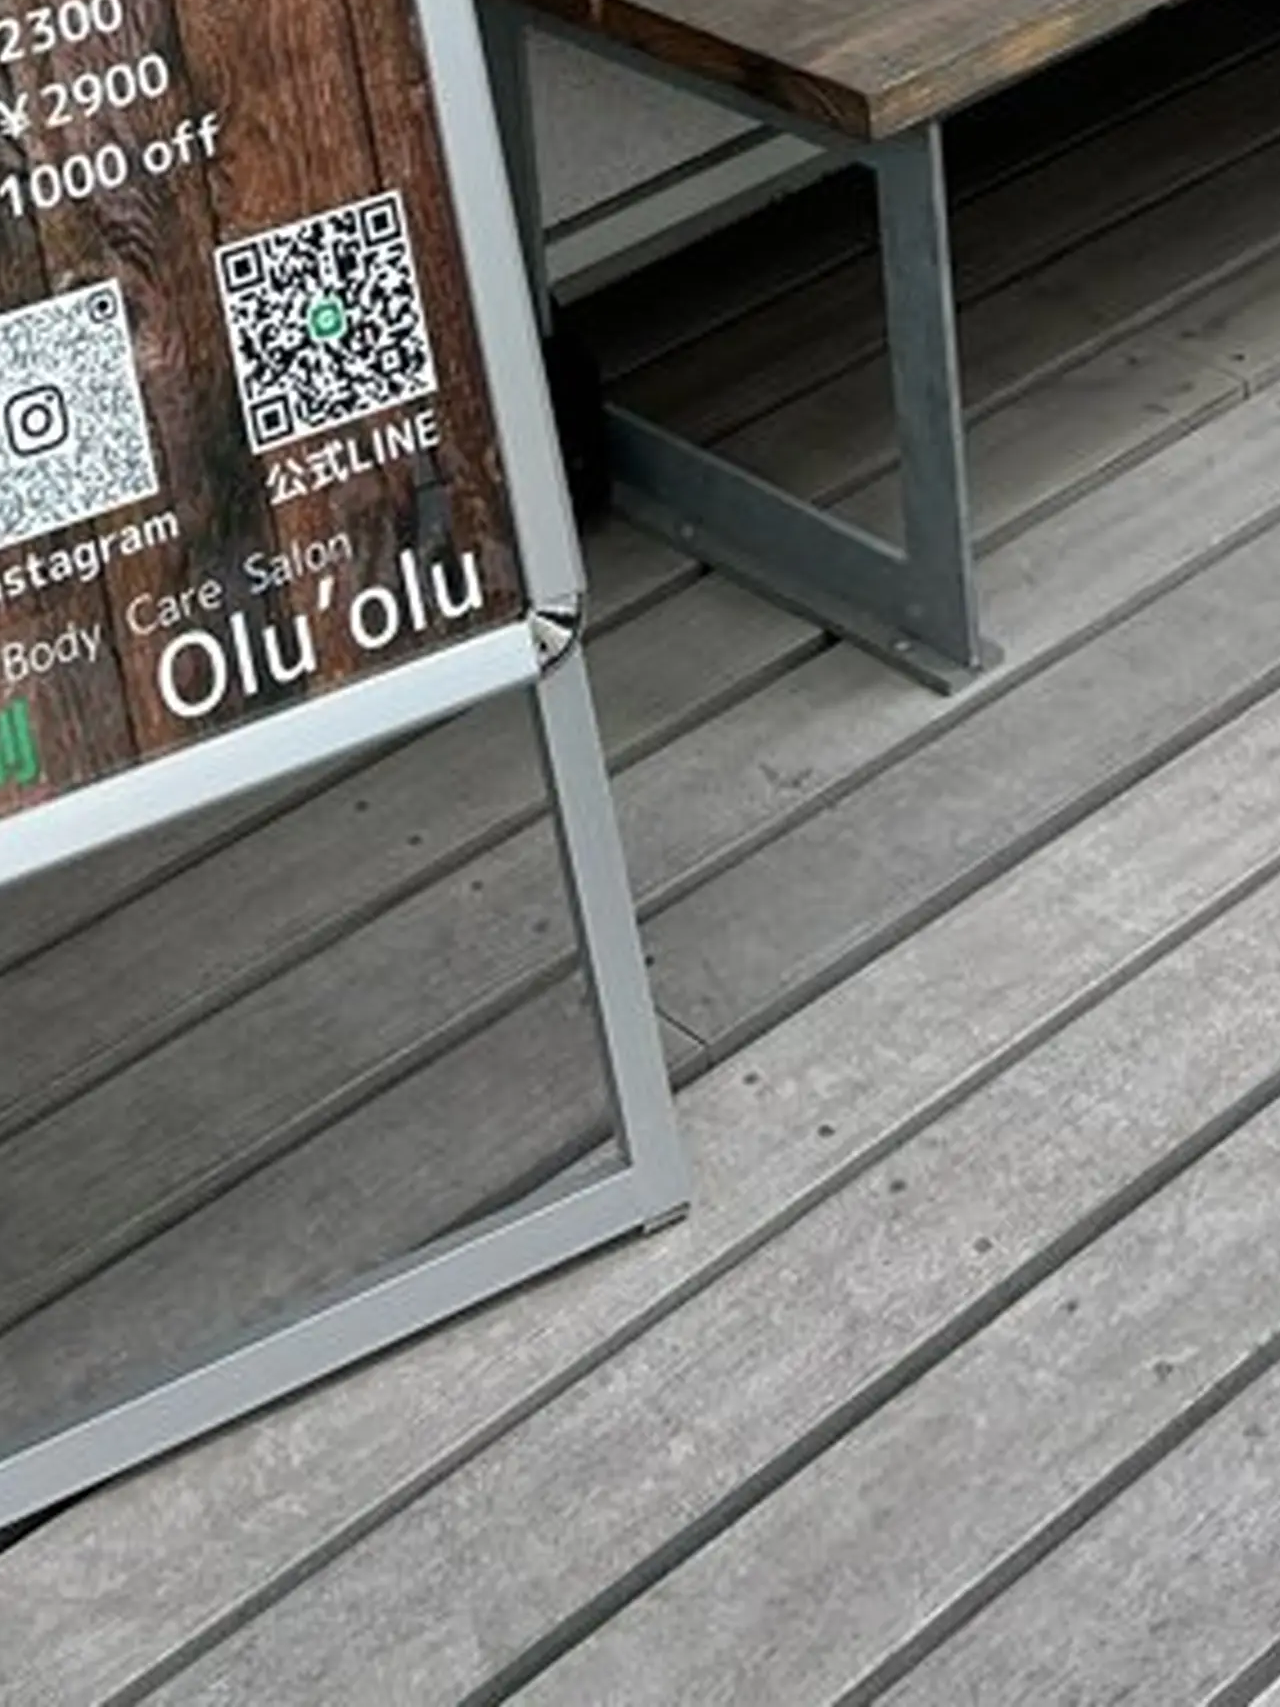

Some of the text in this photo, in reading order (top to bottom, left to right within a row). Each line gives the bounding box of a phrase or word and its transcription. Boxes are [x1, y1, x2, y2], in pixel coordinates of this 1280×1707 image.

[143, 112, 222, 174] off
[266, 410, 441, 505] 公式LINE
[1, 531, 353, 683] Body Care Salon
